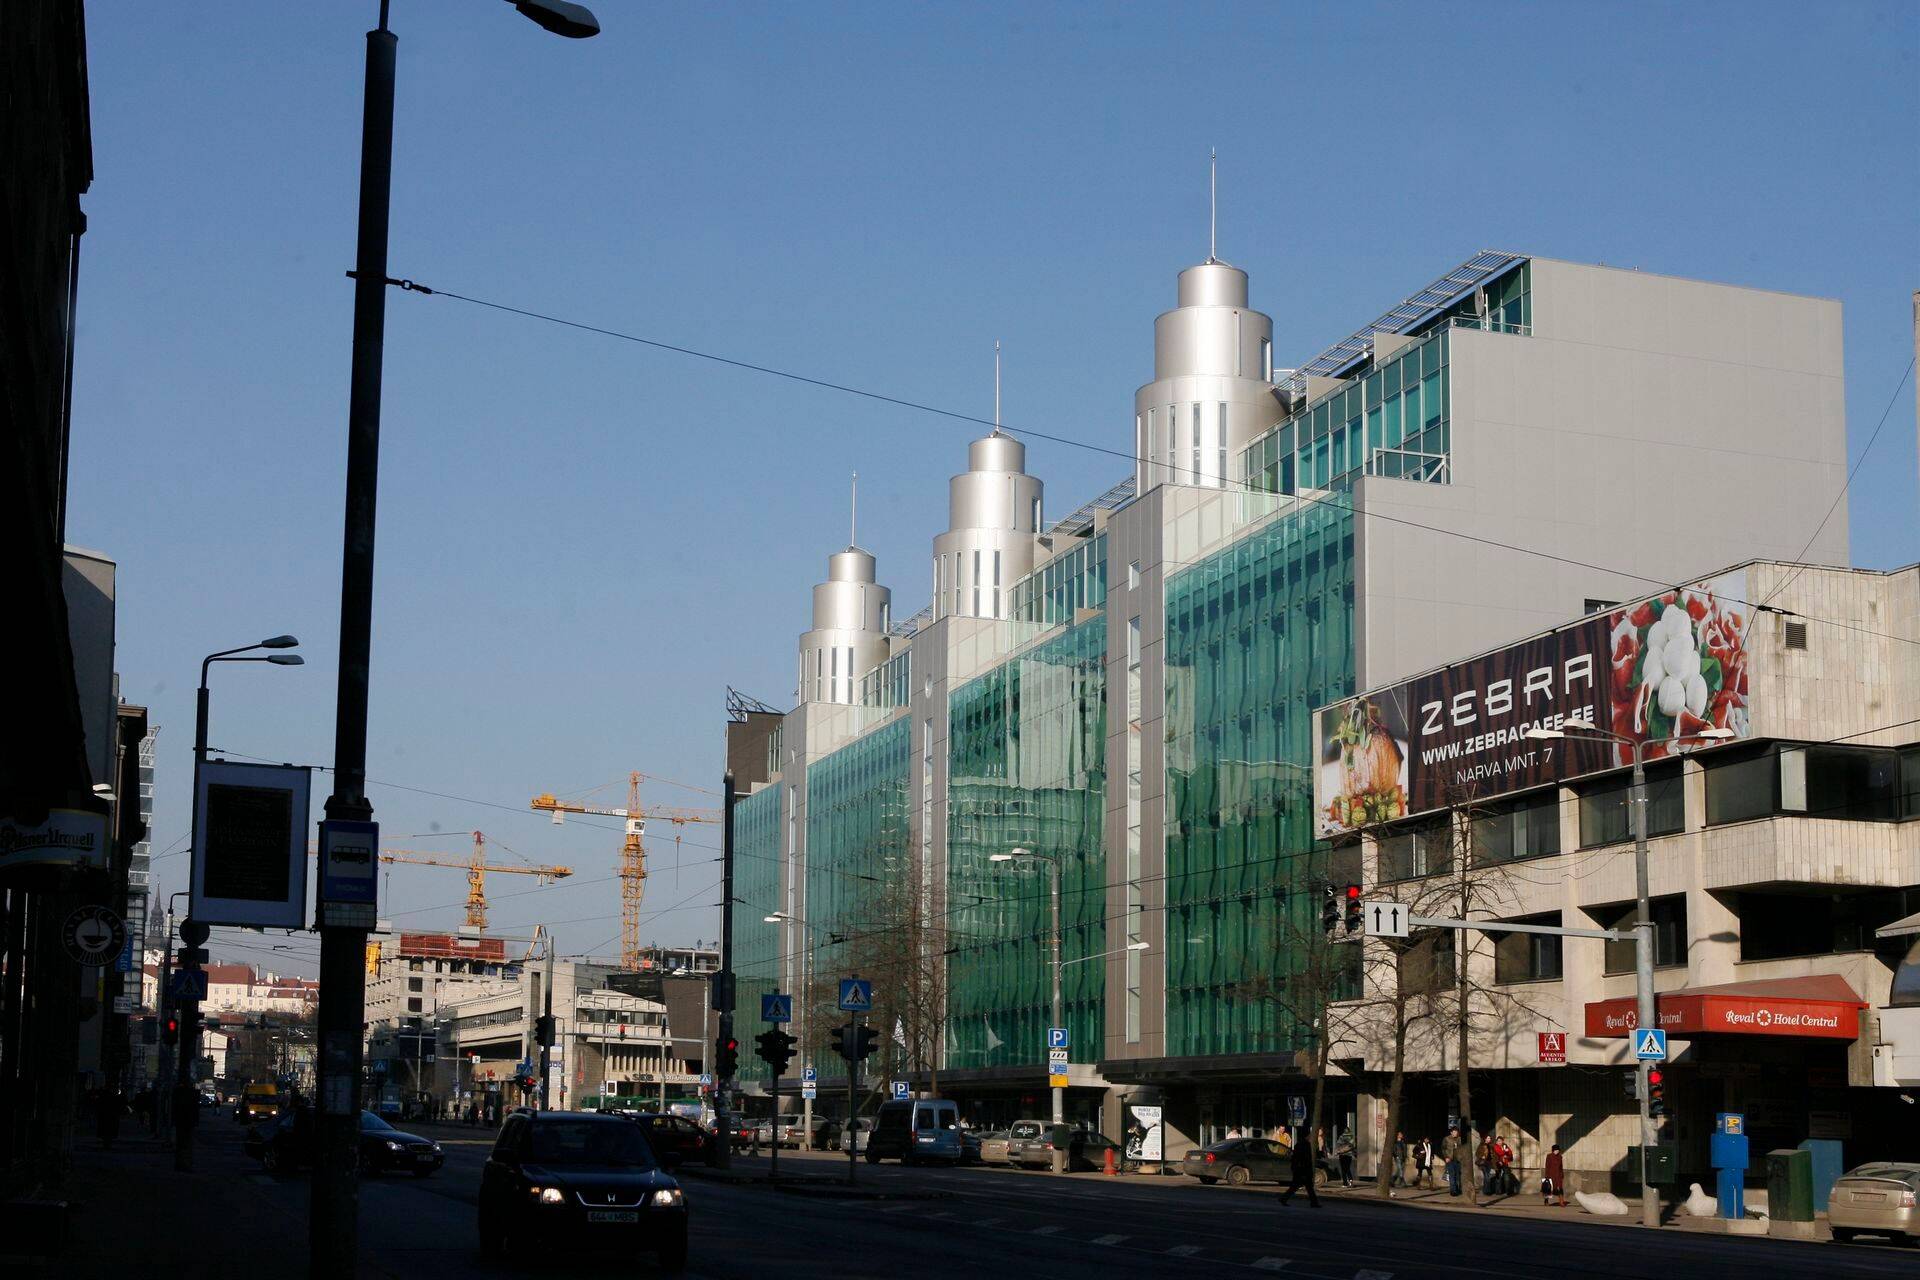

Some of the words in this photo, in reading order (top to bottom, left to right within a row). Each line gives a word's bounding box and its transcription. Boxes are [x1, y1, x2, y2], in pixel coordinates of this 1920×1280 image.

[1421, 653, 1593, 736] ZEBRA
[1422, 704, 1594, 766] WWW.ZEBRACAFEEE
[1456, 762, 1501, 784] NARVA
[1505, 751, 1539, 774] MNT.
[1543, 747, 1553, 763] 7
[47, 827, 95, 850] Urquell
[1606, 1014, 1625, 1029] Reval
[1725, 1009, 1755, 1025] Reval
[1773, 1013, 1800, 1026] Hotel
[1801, 1014, 1838, 1028] Central
[1053, 1031, 1063, 1046] P
[897, 1082, 906, 1094] P
[1727, 1117, 1740, 1128] P
